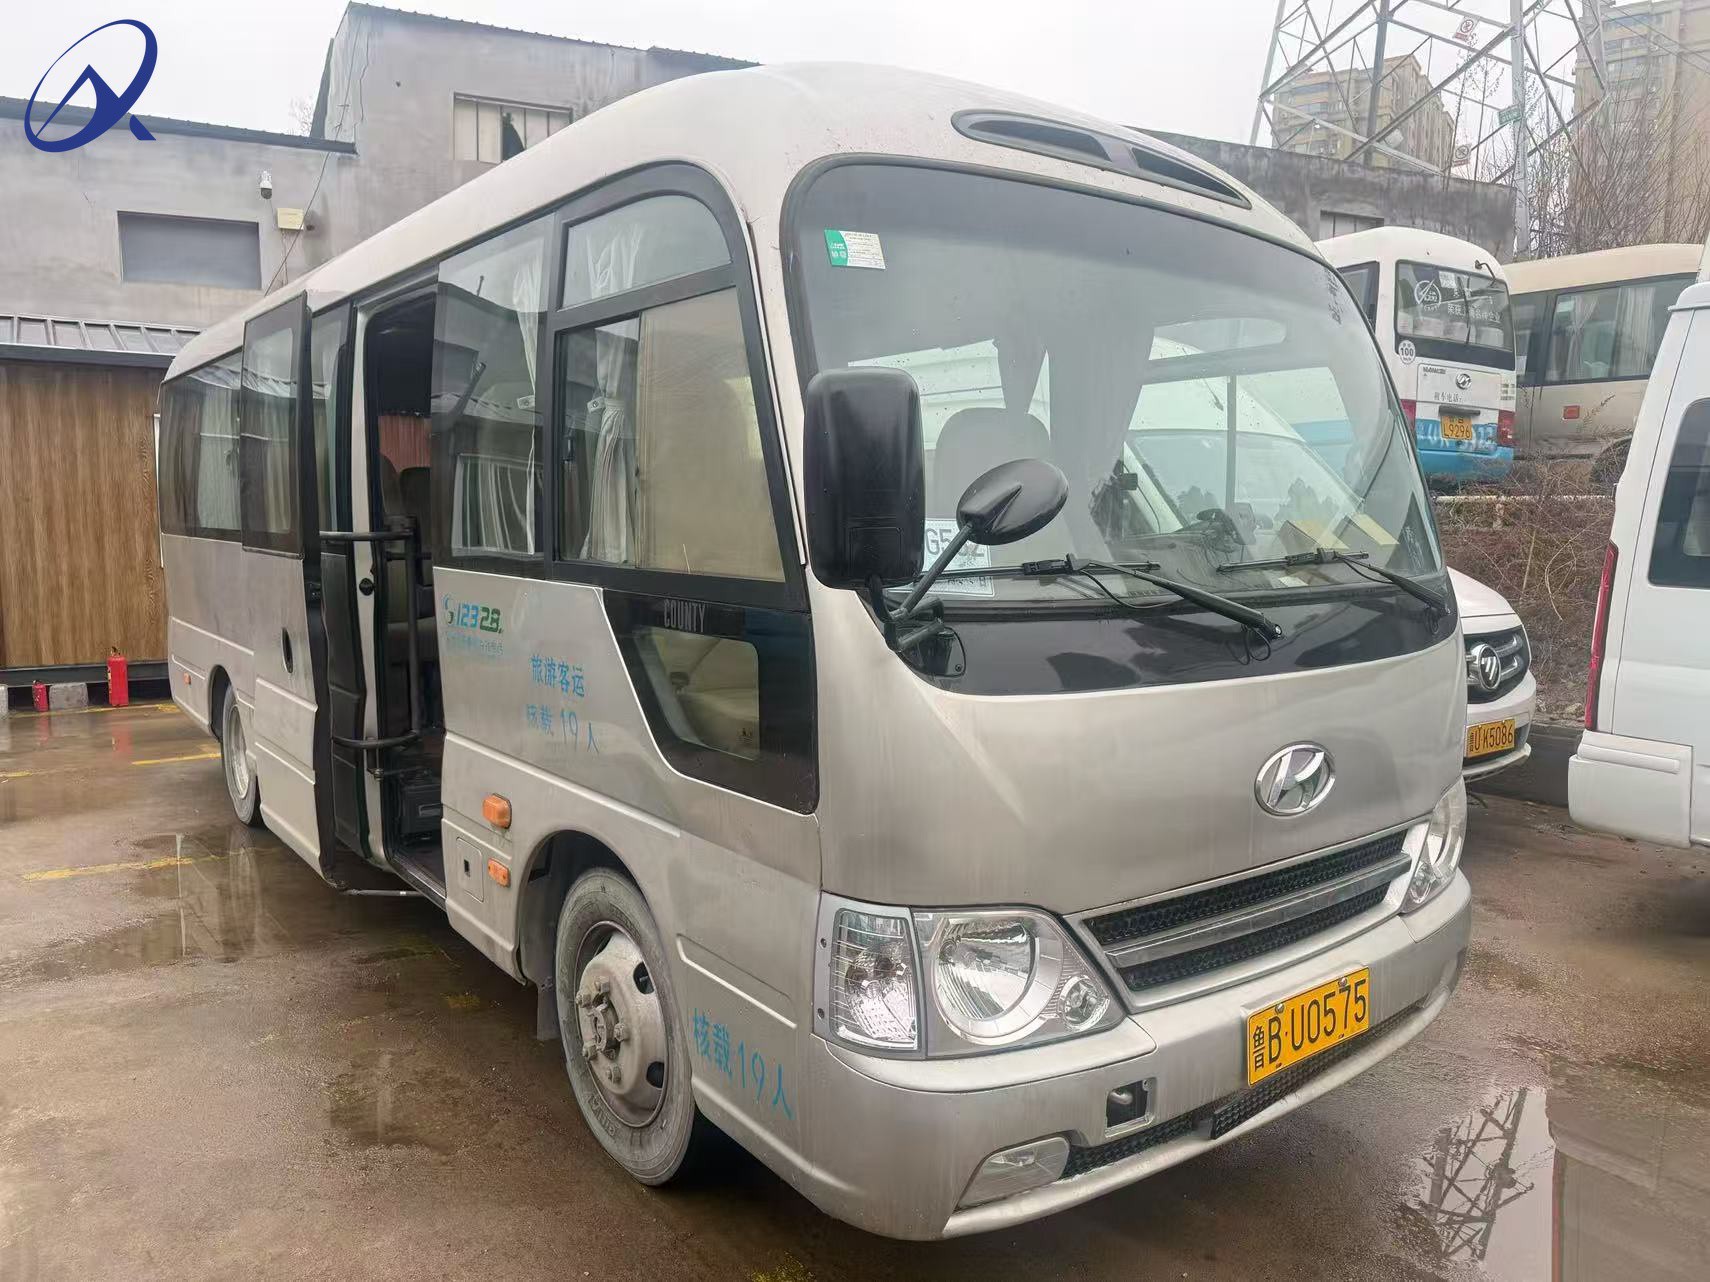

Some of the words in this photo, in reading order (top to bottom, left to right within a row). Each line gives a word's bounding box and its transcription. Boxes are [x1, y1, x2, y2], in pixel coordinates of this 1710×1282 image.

[1400, 347, 1414, 357] 100
[1443, 423, 1471, 439] L9296
[664, 599, 706, 633] COUNTY
[531, 655, 585, 697] 旅游客运
